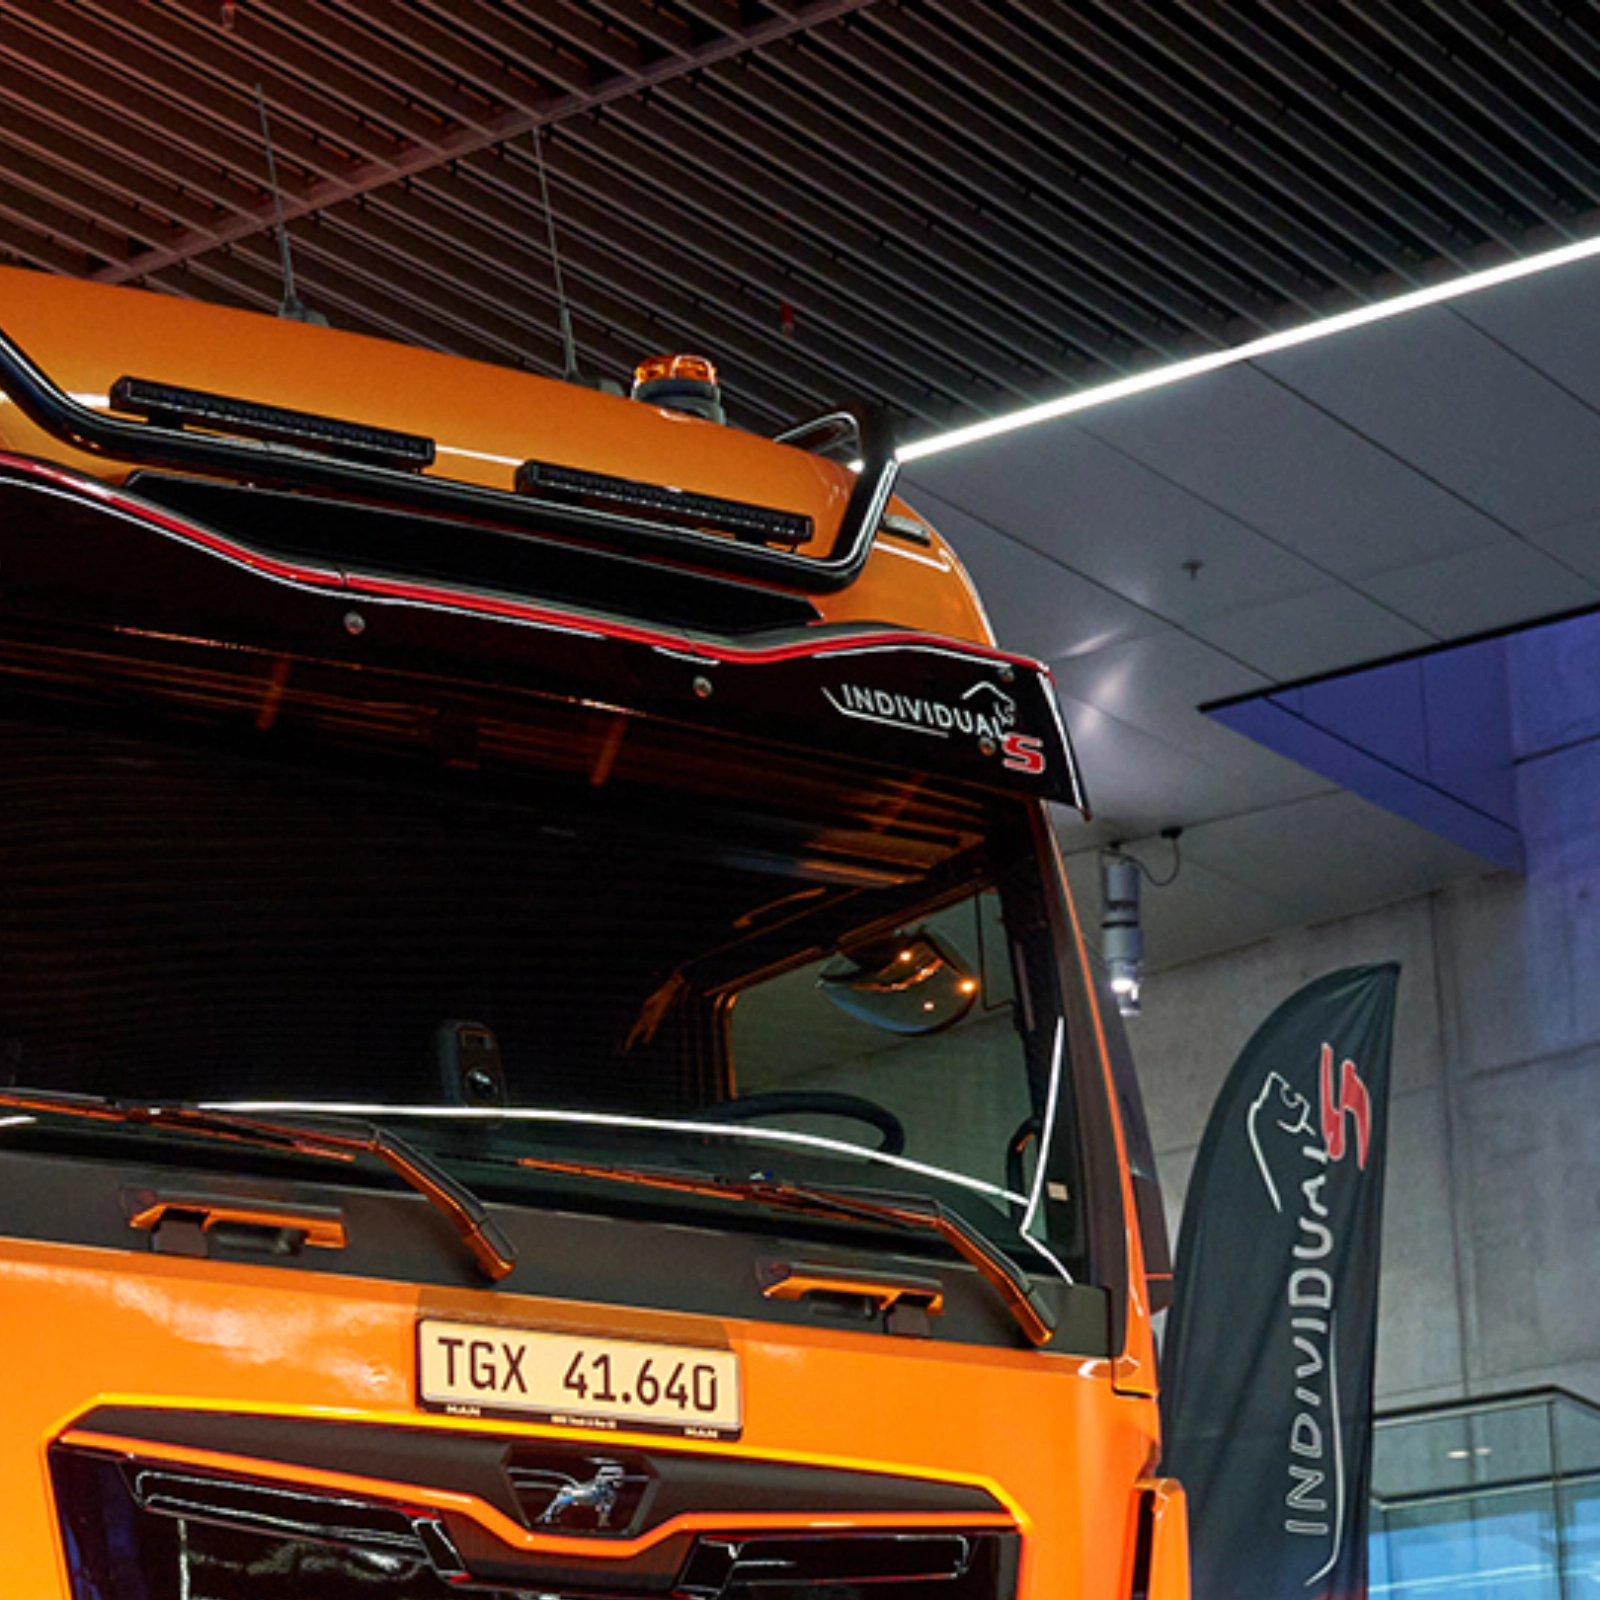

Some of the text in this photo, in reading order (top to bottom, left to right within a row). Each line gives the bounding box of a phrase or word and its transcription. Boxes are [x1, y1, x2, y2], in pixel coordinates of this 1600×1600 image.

[841, 684, 1006, 739] INDIVIDUAL
[438, 1337, 717, 1413] TGX 41.640
